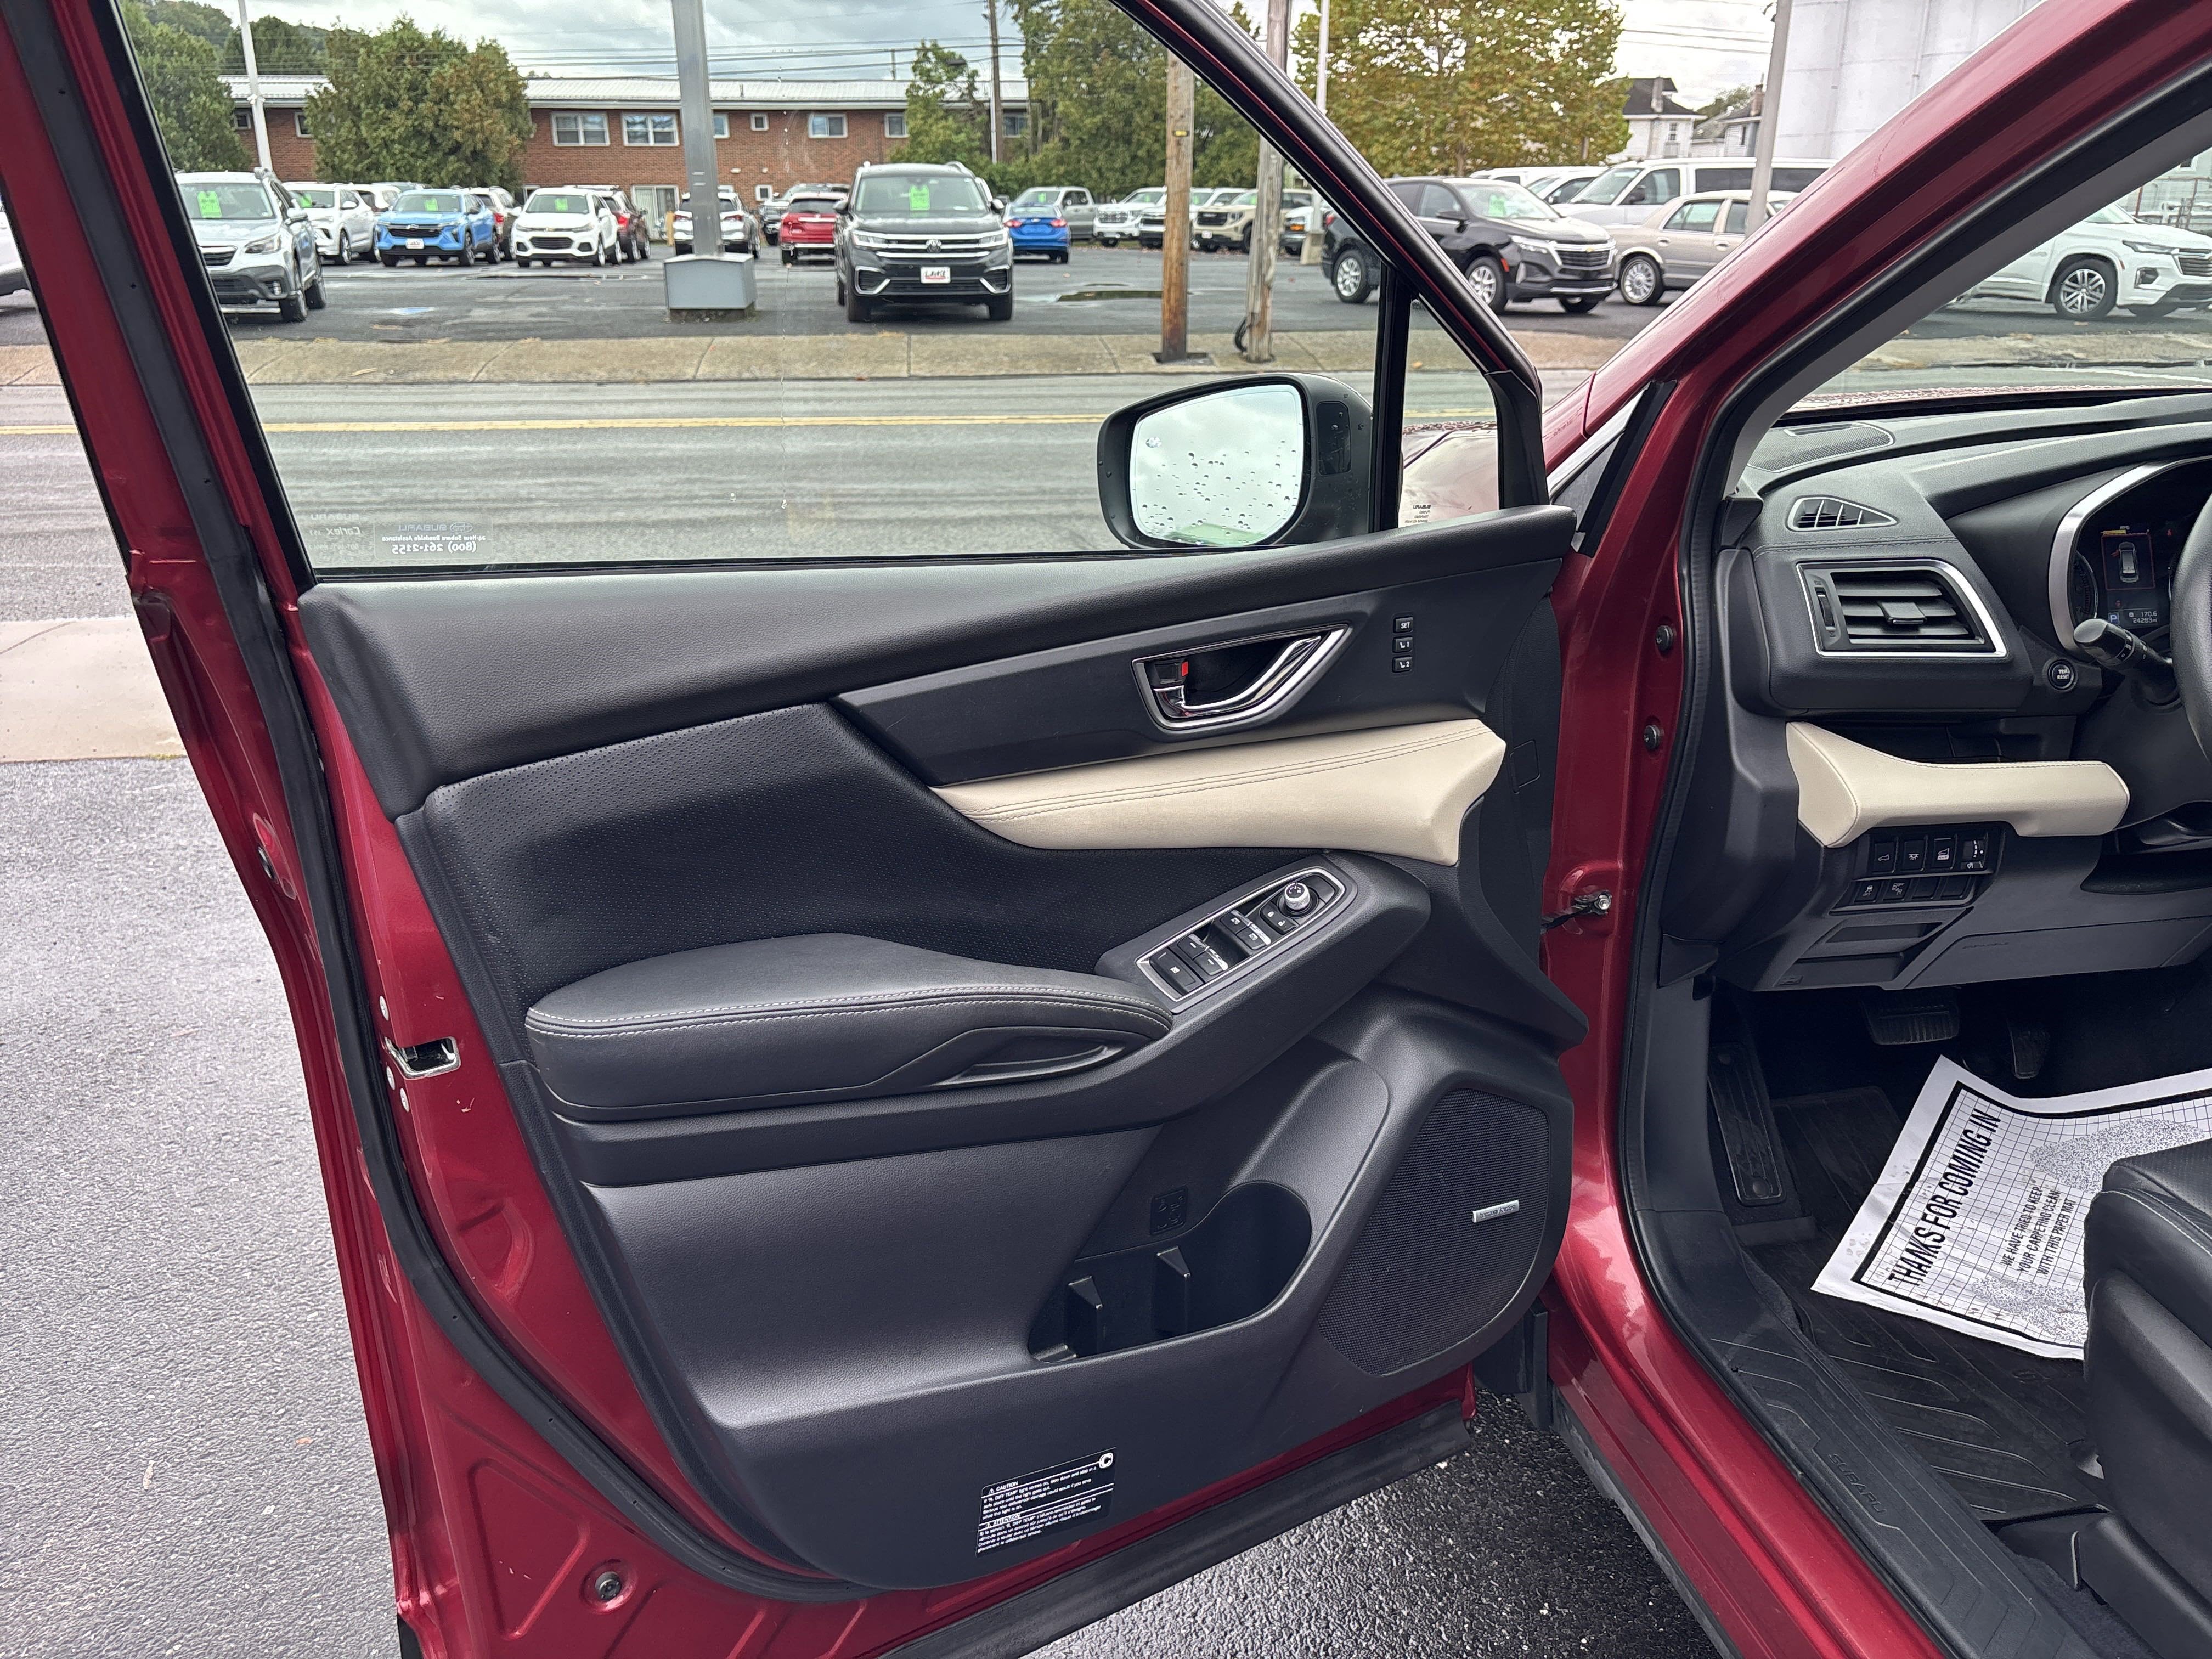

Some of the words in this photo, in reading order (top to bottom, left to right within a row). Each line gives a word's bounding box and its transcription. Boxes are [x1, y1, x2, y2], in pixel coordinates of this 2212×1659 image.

[2110, 614, 2117, 623] P
[1969, 1108, 2001, 1133] IN
[1938, 1128, 1993, 1196] COMING
[2027, 1186, 2044, 1205] KEEP
[2061, 1197, 2076, 1214] MAT
[1921, 1194, 1963, 1231] FOR
[2022, 1204, 2037, 1214] TO
[2014, 1214, 2032, 1232] TRIED
[2017, 1252, 2036, 1273] YOUR
[2027, 1211, 2052, 1251] CARPETING
[2042, 1190, 2061, 1212] CLEAN
[2051, 1213, 2071, 1235] PAPER
[2006, 1232, 2024, 1255] HAVE
[2044, 1235, 2062, 1254] THIS
[1888, 1226, 1946, 1286] THANKS
[2000, 1254, 2016, 1266] WE
[2036, 1254, 2055, 1275] WITH
[996, 1481, 1019, 1492] CAUTION
[1828, 1453, 1887, 1513] SUBARU
